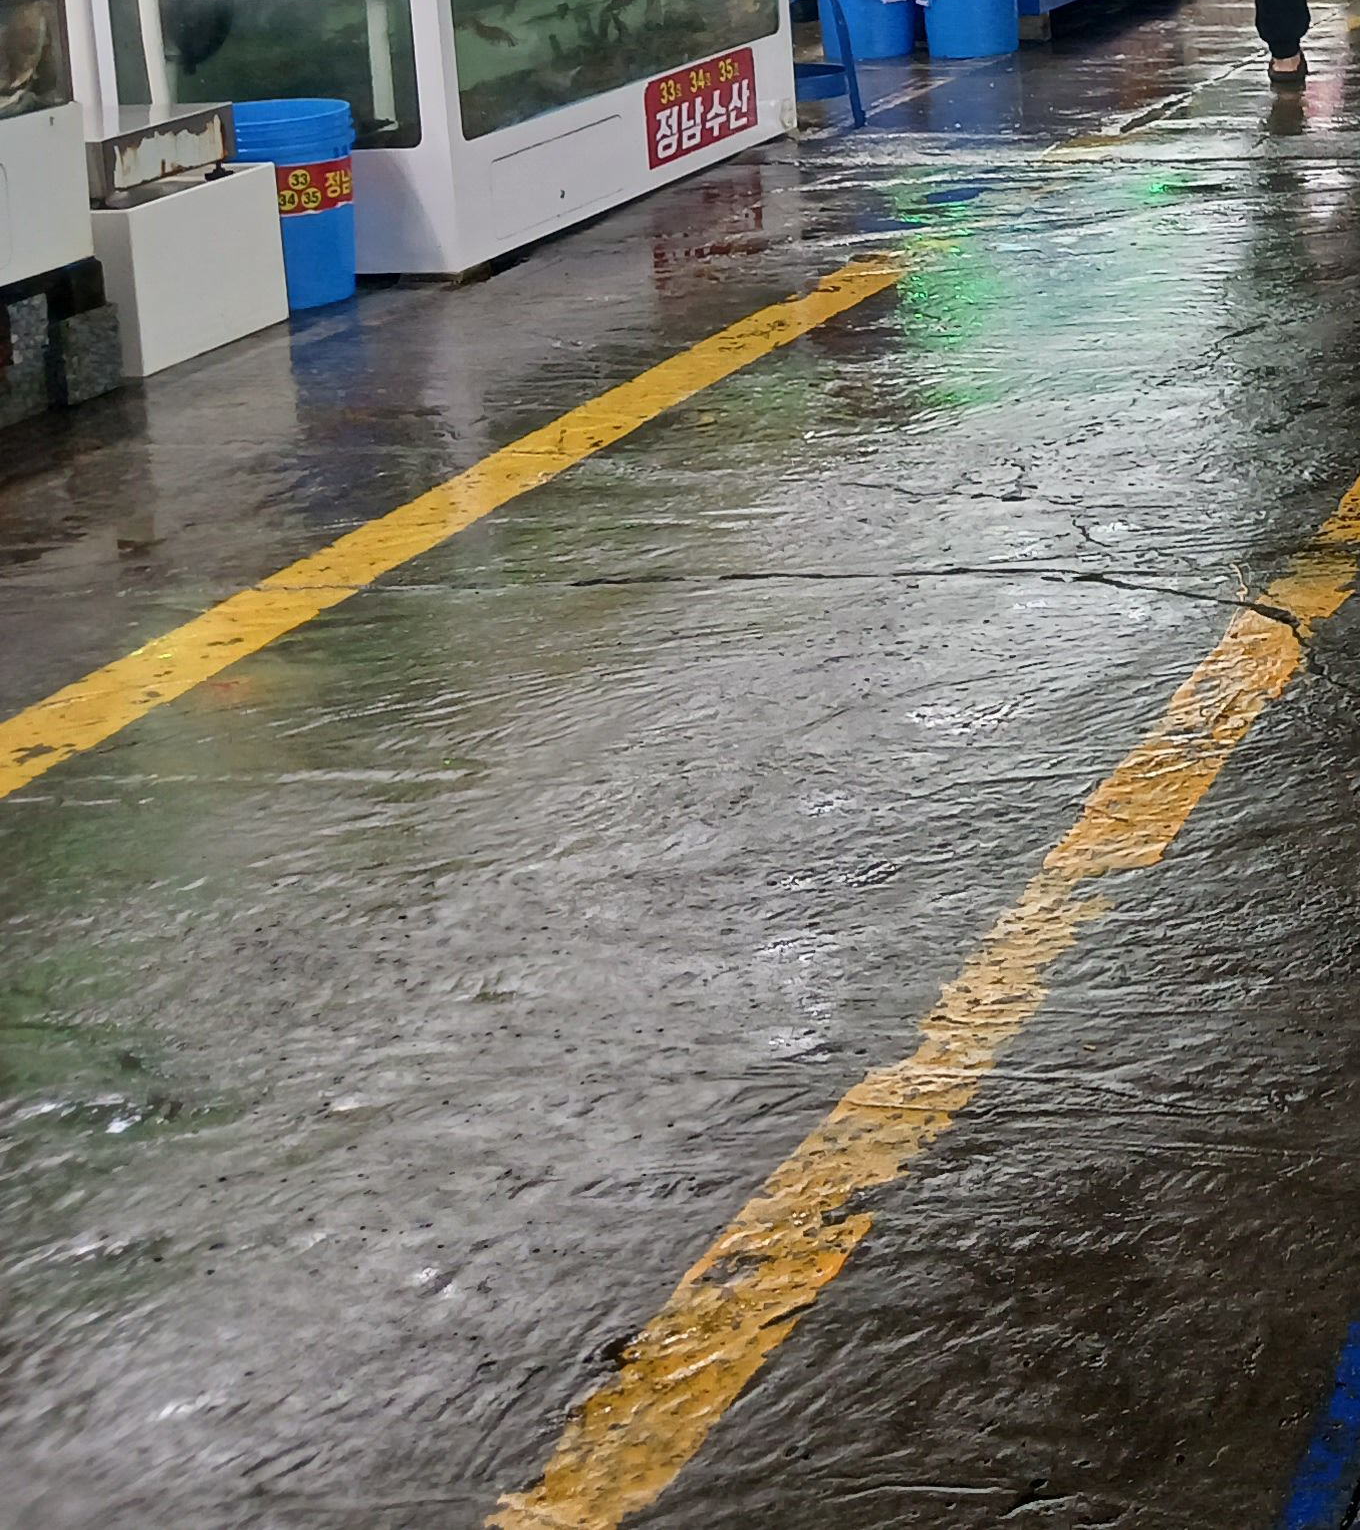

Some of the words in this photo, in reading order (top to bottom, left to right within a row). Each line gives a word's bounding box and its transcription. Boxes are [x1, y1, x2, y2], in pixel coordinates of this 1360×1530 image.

[656, 79, 750, 159] 정남수산
[291, 173, 308, 187] 33
[279, 193, 296, 206] 34
[303, 191, 319, 205] 35
